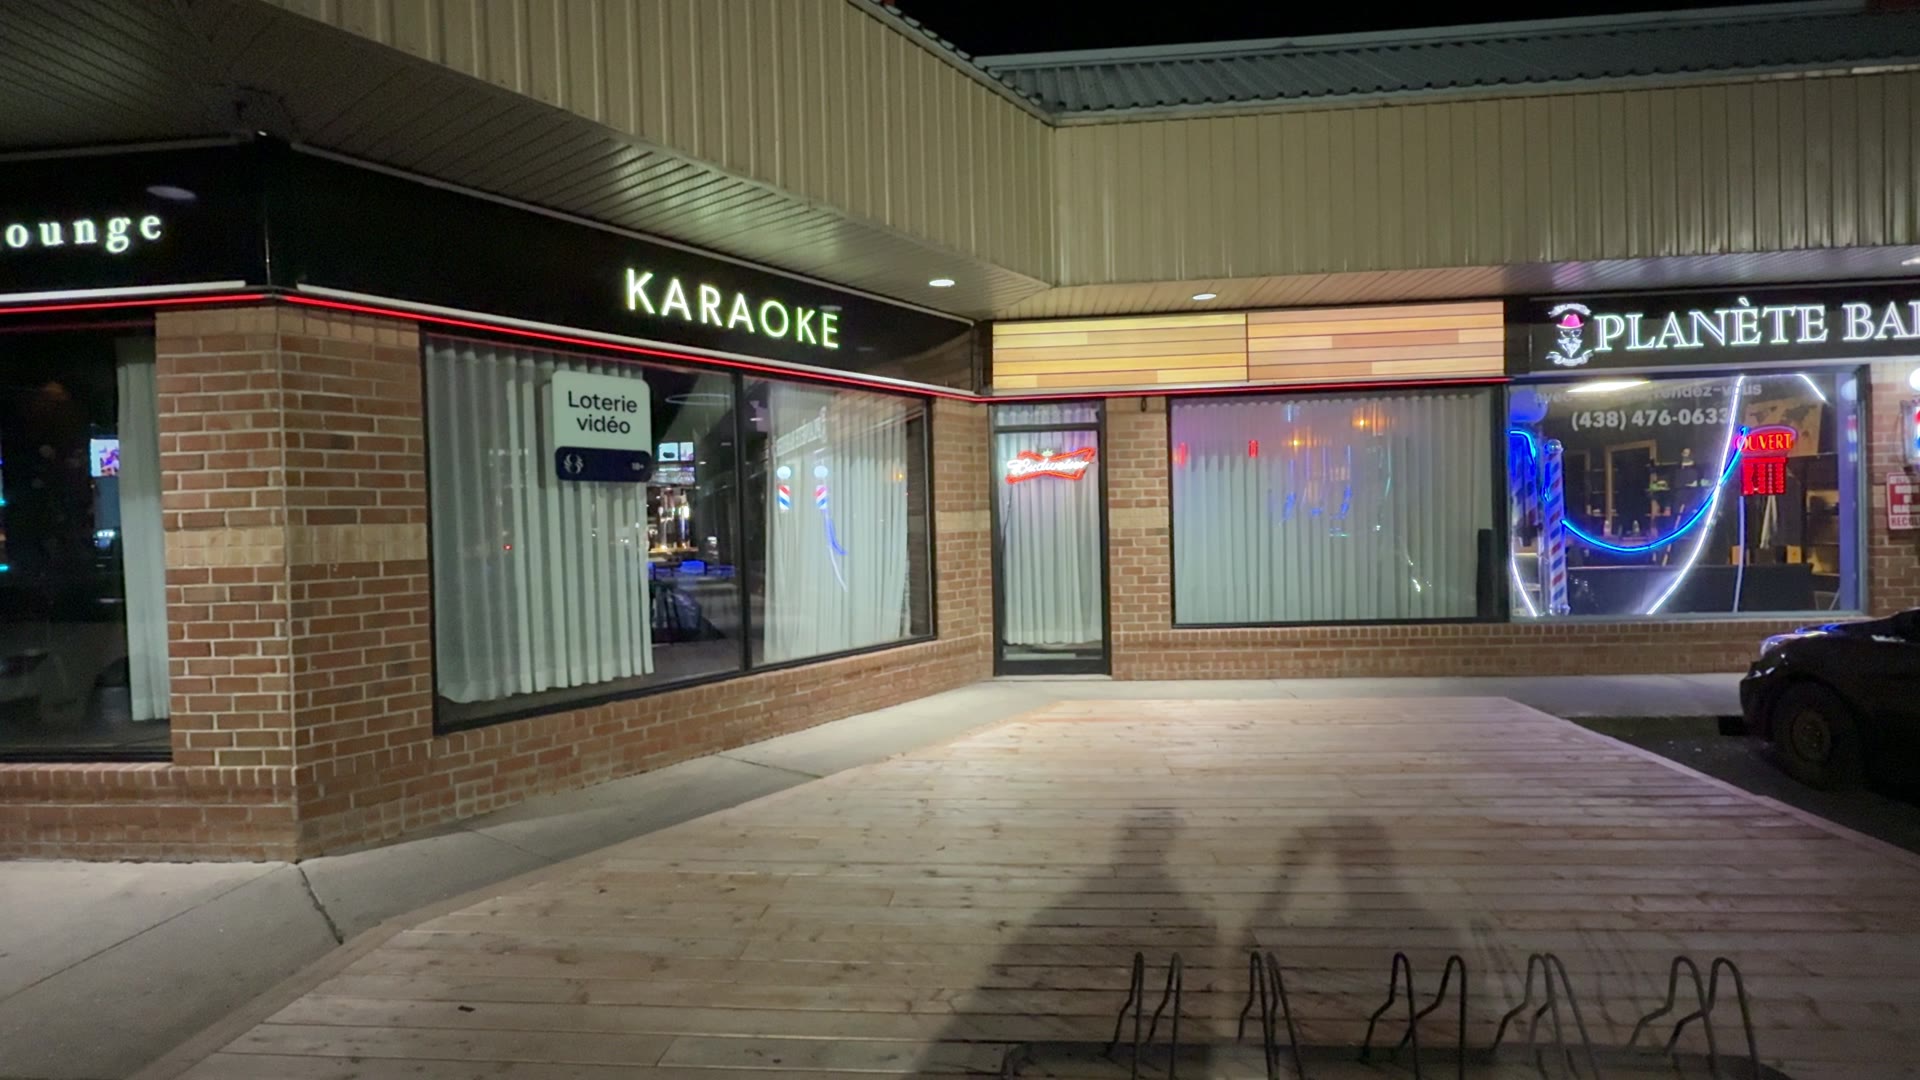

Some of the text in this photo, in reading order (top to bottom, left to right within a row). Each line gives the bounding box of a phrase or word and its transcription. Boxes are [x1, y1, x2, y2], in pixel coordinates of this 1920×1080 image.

[625, 267, 840, 350] KARAOKE
[1593, 296, 1829, 353] PLANÈTE
[567, 390, 638, 414] Loterie
[1654, 382, 1764, 400] rendez-vus
[576, 414, 632, 434] vidéo
[1571, 407, 1729, 432] (438) 476-0633
[1735, 433, 1793, 451] OUVERT
